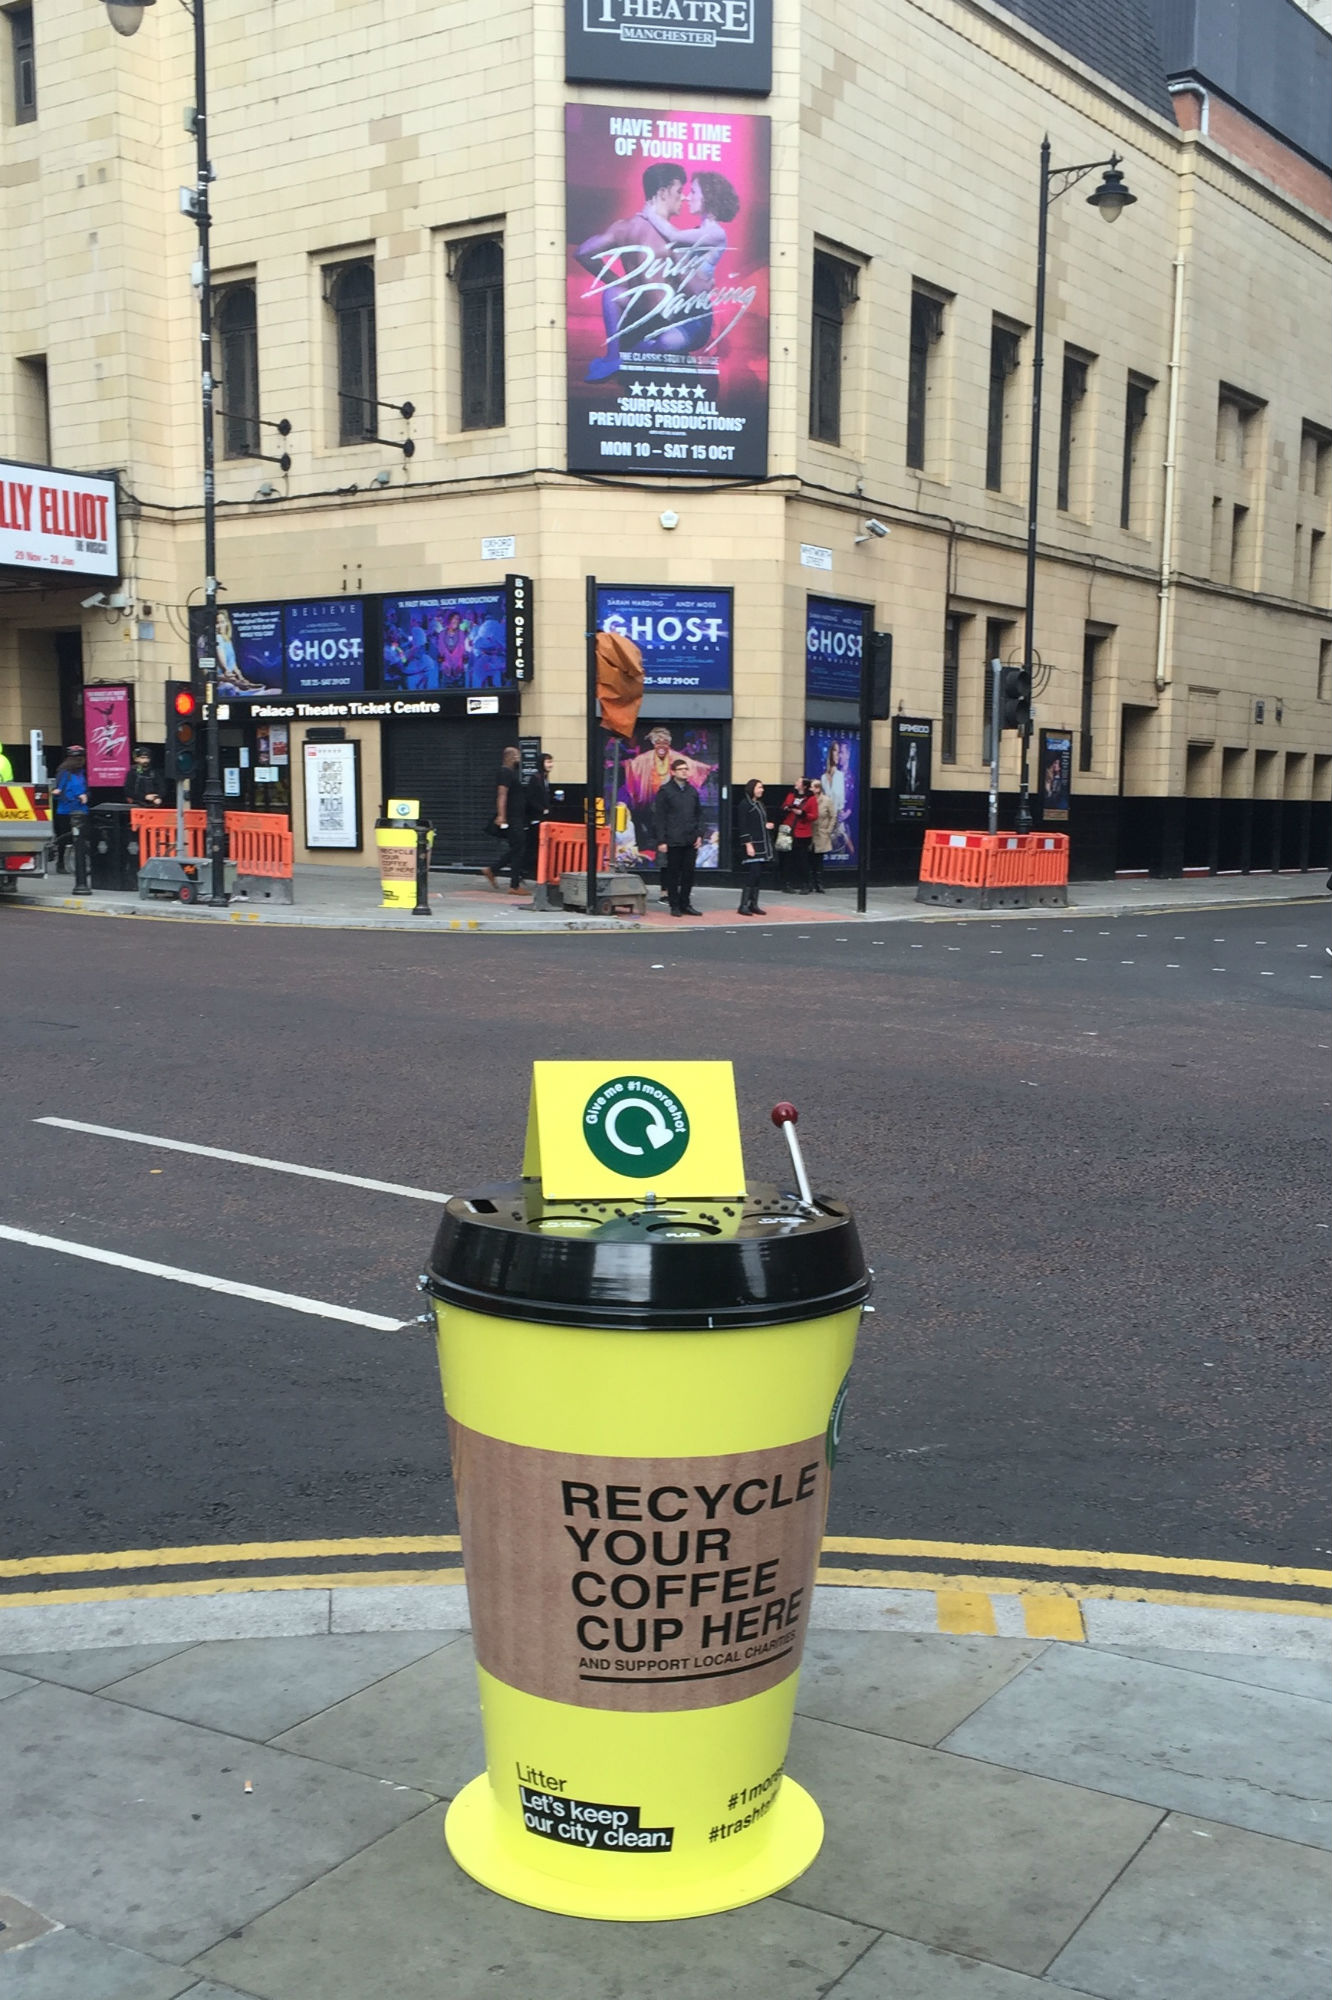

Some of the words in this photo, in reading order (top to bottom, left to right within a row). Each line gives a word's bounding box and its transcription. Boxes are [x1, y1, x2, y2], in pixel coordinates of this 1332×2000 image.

[599, 0, 748, 31] THEATRE
[623, 27, 713, 44] MANCHESTER
[610, 117, 652, 137] HAVE
[656, 120, 687, 140] THE
[692, 122, 731, 142] TIME
[615, 138, 637, 156] OF
[641, 140, 683, 160] YOUR
[688, 143, 721, 161] LIFE
[580, 240, 738, 298] Dirty
[603, 273, 757, 353] Dancing
[589, 411, 652, 428] PREVIOUS
[695, 401, 719, 415] ALL
[600, 441, 631, 456] MON
[634, 442, 651, 457] 10
[664, 443, 688, 459] SAT
[691, 445, 707, 460] 15
[708, 445, 735, 460] OCT
[39, 486, 109, 541] ELLIOT
[515, 578, 524, 609] BOX
[292, 605, 356, 616] BELIEVE
[603, 614, 723, 643] GHOST
[807, 626, 862, 658] GHOST
[288, 638, 362, 662] GHOST
[515, 616, 524, 678] OFFICE
[251, 704, 294, 717] Palace
[296, 704, 347, 717] Theatre
[349, 702, 391, 715] Ticket
[394, 701, 440, 713] Centre
[586, 1096, 606, 1124] Give
[604, 1083, 624, 1099] me
[627, 1081, 687, 1133] #1moreshot
[561, 1461, 819, 1522] RECYCLE
[564, 1525, 731, 1566] YOUR
[571, 1558, 779, 1609] COFFEE
[577, 1615, 683, 1652] CUP
[701, 1587, 804, 1648] HERE
[578, 1657, 611, 1670] AND
[614, 1658, 690, 1671] SUPPORT
[693, 1652, 741, 1668] LOCAL
[516, 1762, 567, 1792] Litter
[524, 1812, 554, 1833] our
[558, 1821, 598, 1847] city
[604, 1828, 671, 1848] clean.
[570, 1801, 629, 1830] keep
